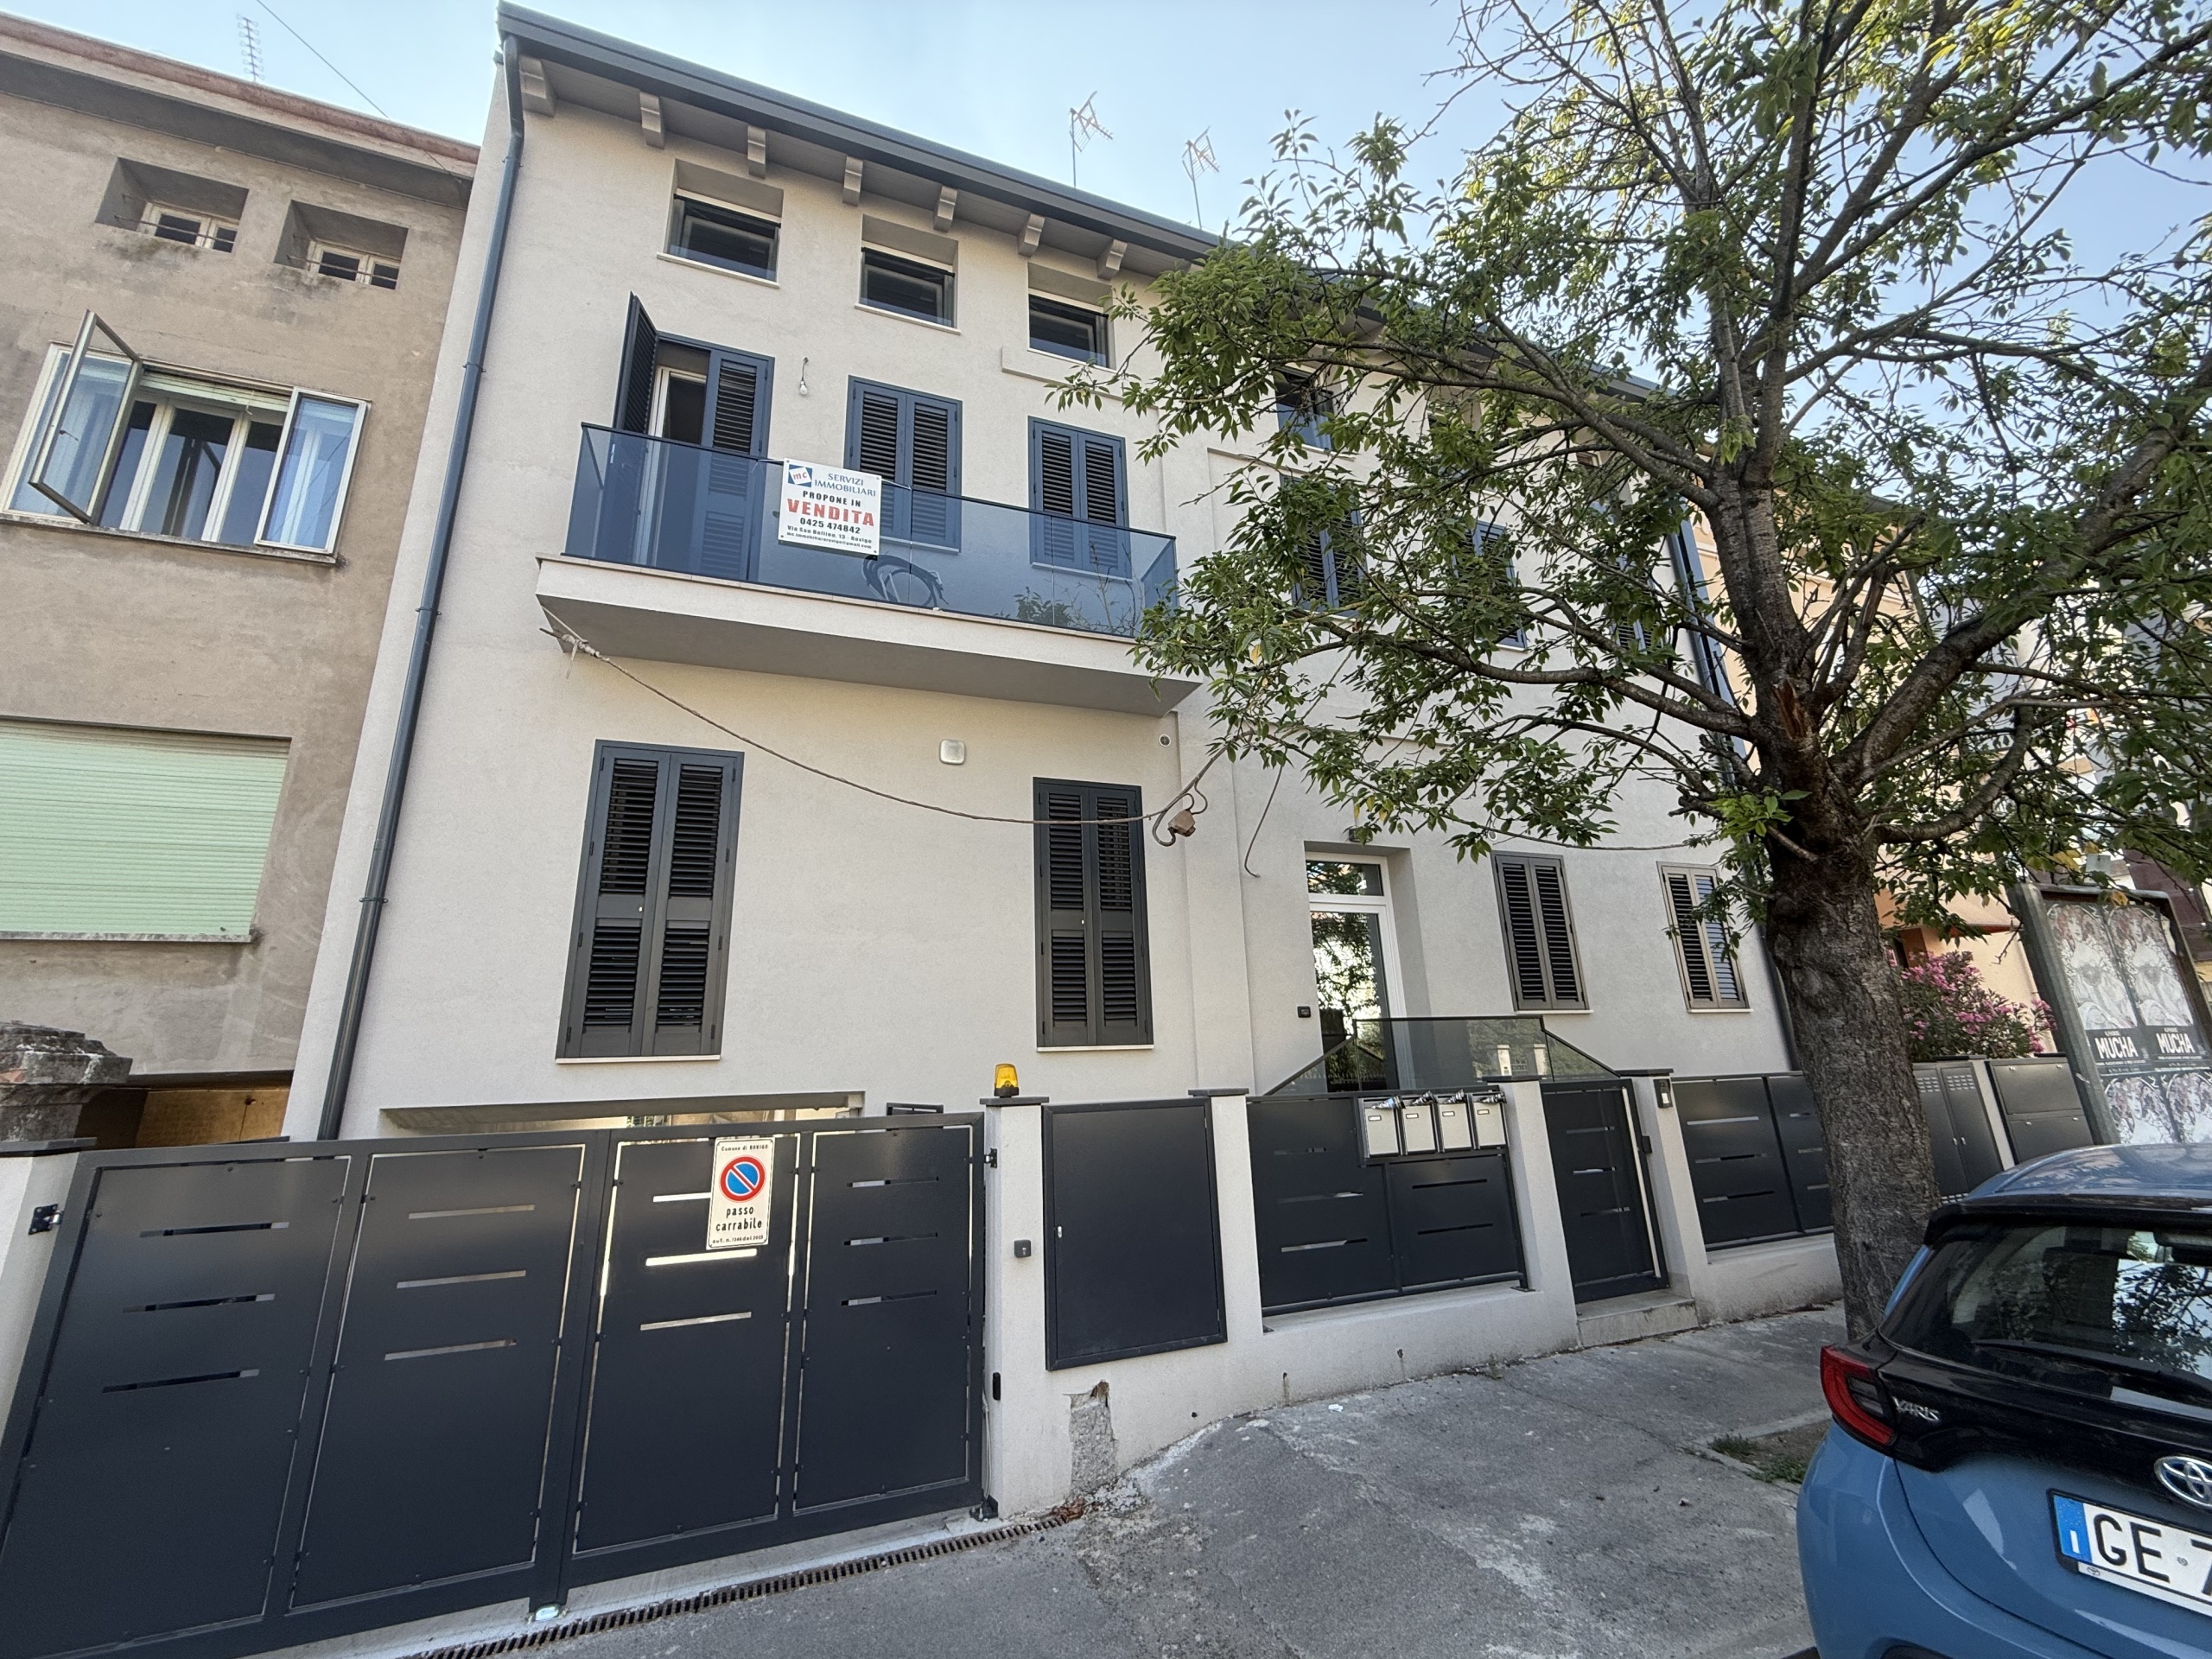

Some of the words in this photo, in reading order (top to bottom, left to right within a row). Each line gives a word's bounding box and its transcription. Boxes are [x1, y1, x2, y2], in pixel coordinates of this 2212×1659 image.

[828, 473, 864, 486] SERVIZI
[814, 480, 876, 497] IMMOBILIARI
[803, 490, 848, 505] PROPONE
[787, 499, 874, 526] VENDITA
[800, 518, 824, 528] 0425
[827, 522, 861, 534] 474842
[2094, 1036, 2139, 1059] MUCHA
[2156, 1033, 2196, 1054] MUCHA
[726, 1206, 754, 1218] passo
[715, 1217, 762, 1231] carrabile
